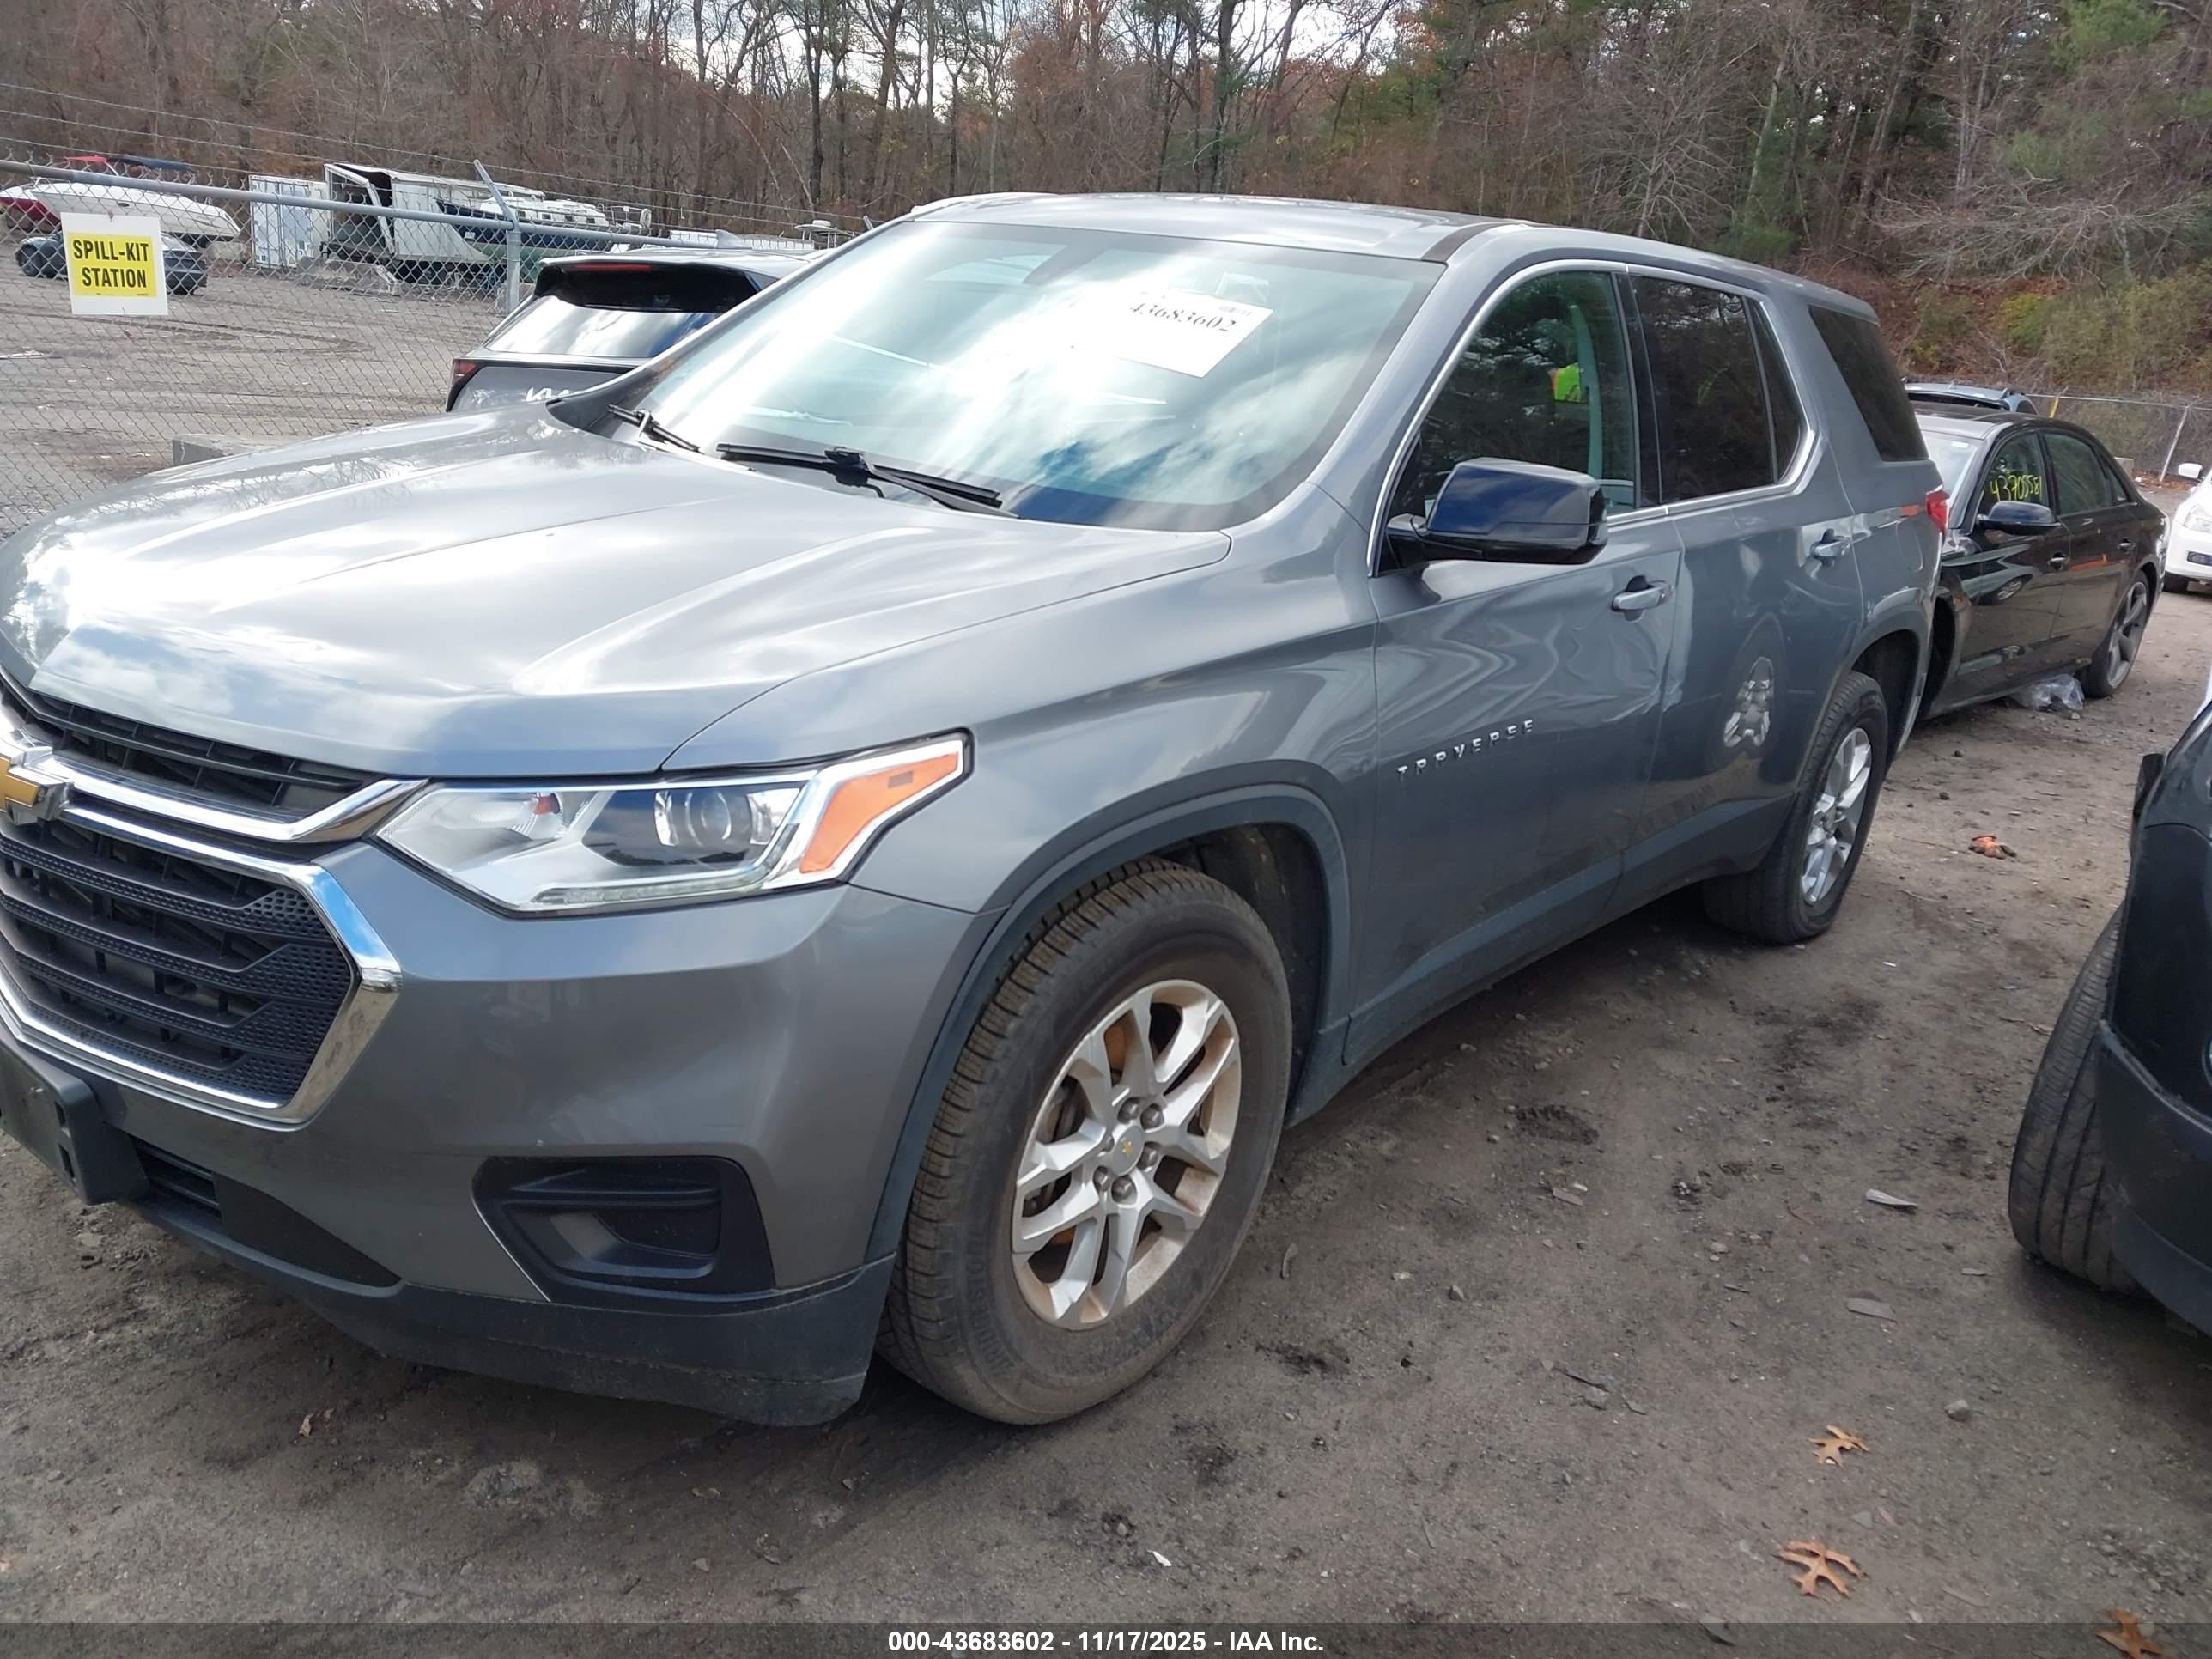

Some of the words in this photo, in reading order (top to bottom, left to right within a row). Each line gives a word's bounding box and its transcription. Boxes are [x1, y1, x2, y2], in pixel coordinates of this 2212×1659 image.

[73, 239, 149, 262] SPILL-KIT
[82, 266, 147, 288] STATION
[1129, 302, 1237, 331] 43683602
[1396, 719, 1534, 781] TRAVERSE
